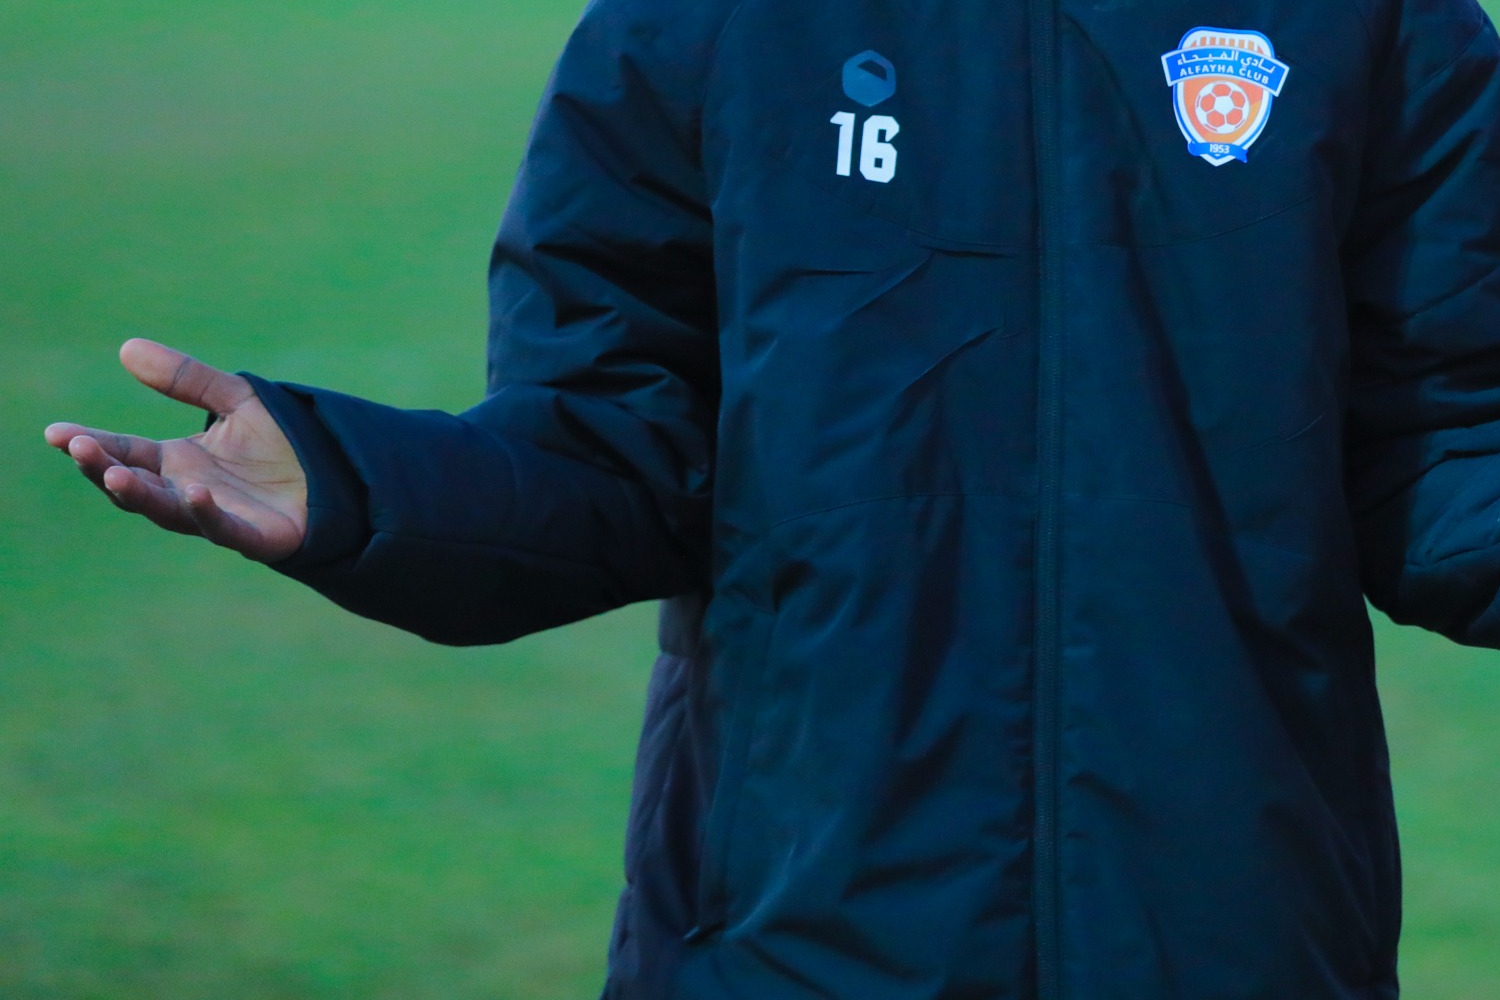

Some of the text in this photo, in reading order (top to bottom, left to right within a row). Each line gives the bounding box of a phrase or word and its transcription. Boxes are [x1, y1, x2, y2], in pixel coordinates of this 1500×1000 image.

[1177, 50, 1276, 74] نادي الفيحاء
[1180, 64, 1270, 85] ALFAYHA CLUB
[829, 110, 900, 184] 16
[1209, 143, 1230, 154] 1953
